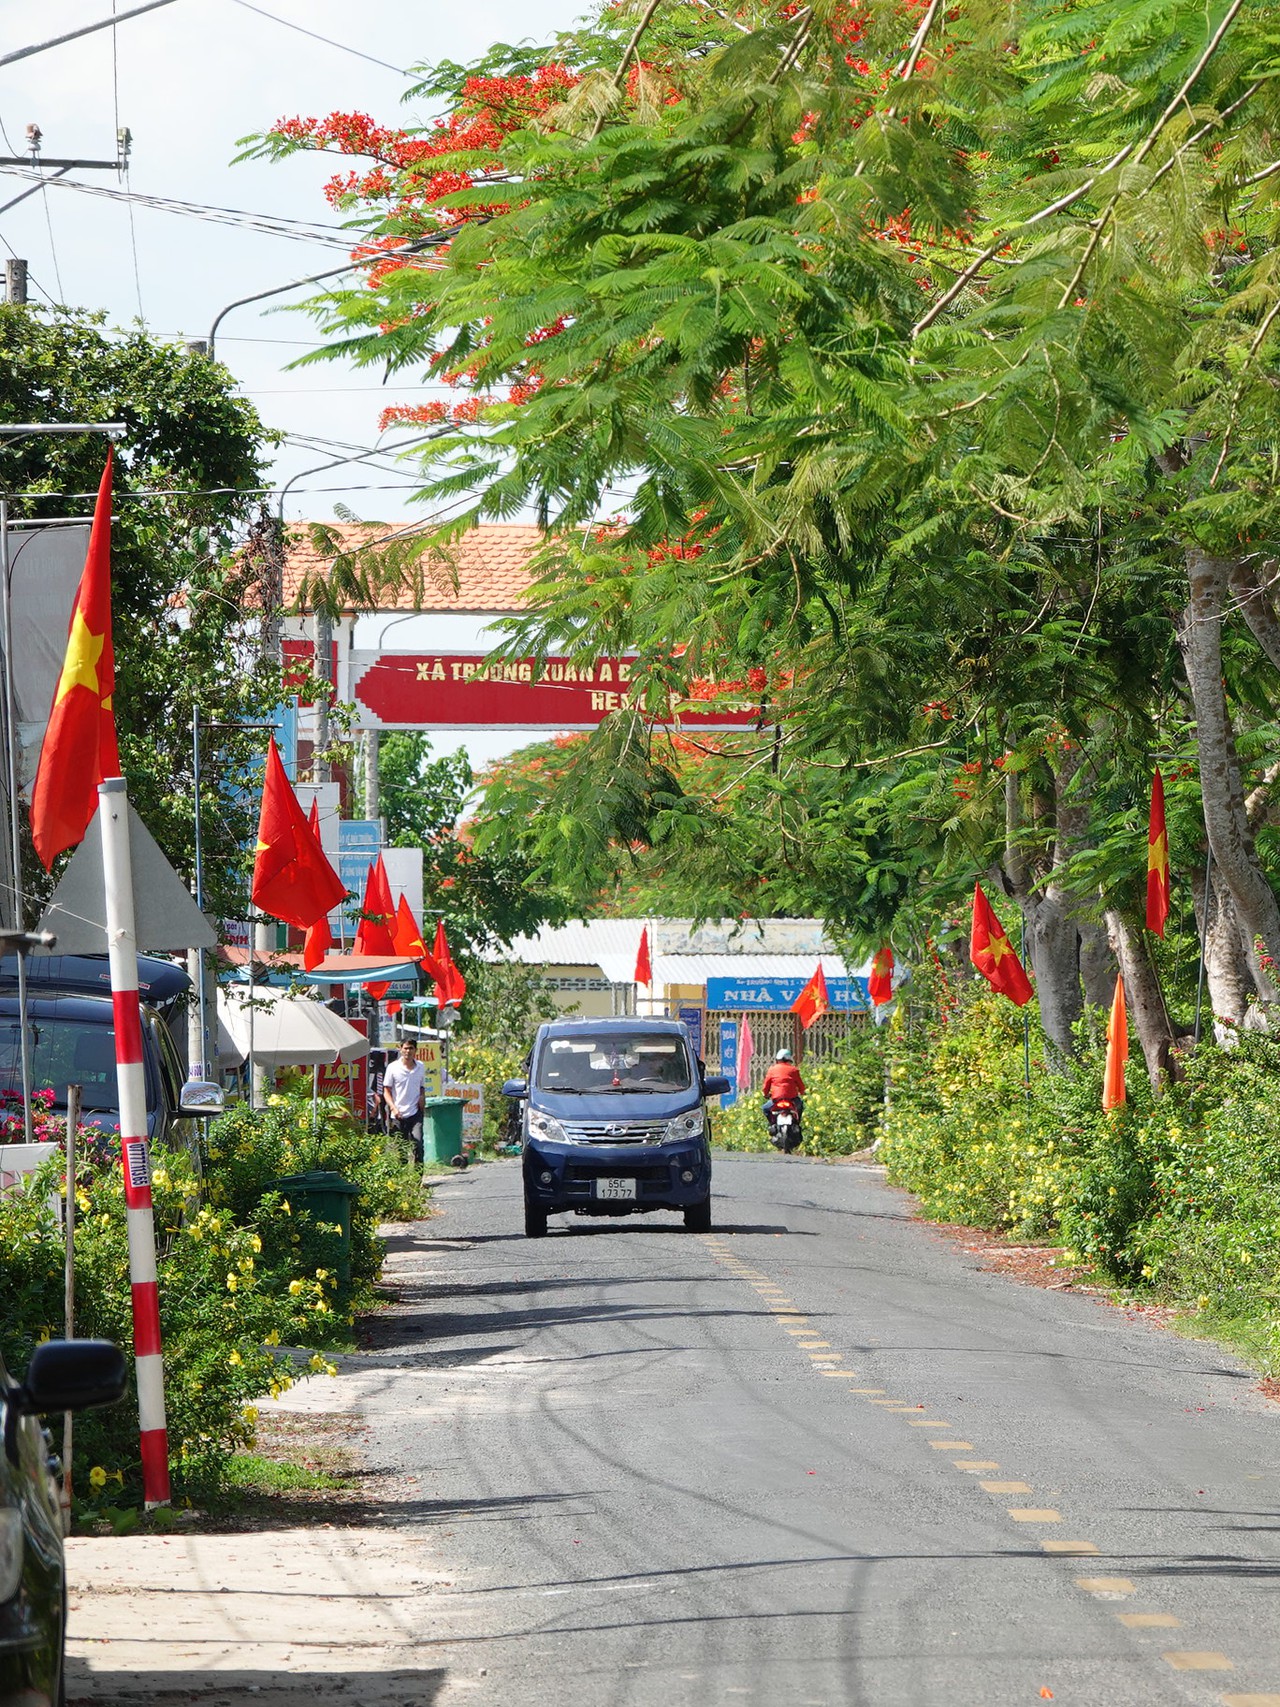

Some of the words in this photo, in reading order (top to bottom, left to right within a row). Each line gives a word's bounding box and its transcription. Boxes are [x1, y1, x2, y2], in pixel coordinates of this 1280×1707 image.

[415, 658, 446, 681] XÃ
[599, 663, 613, 682] A
[723, 987, 774, 1002] NHÀ
[608, 1178, 626, 1189] 65C
[601, 1189, 632, 1198] 173.77
